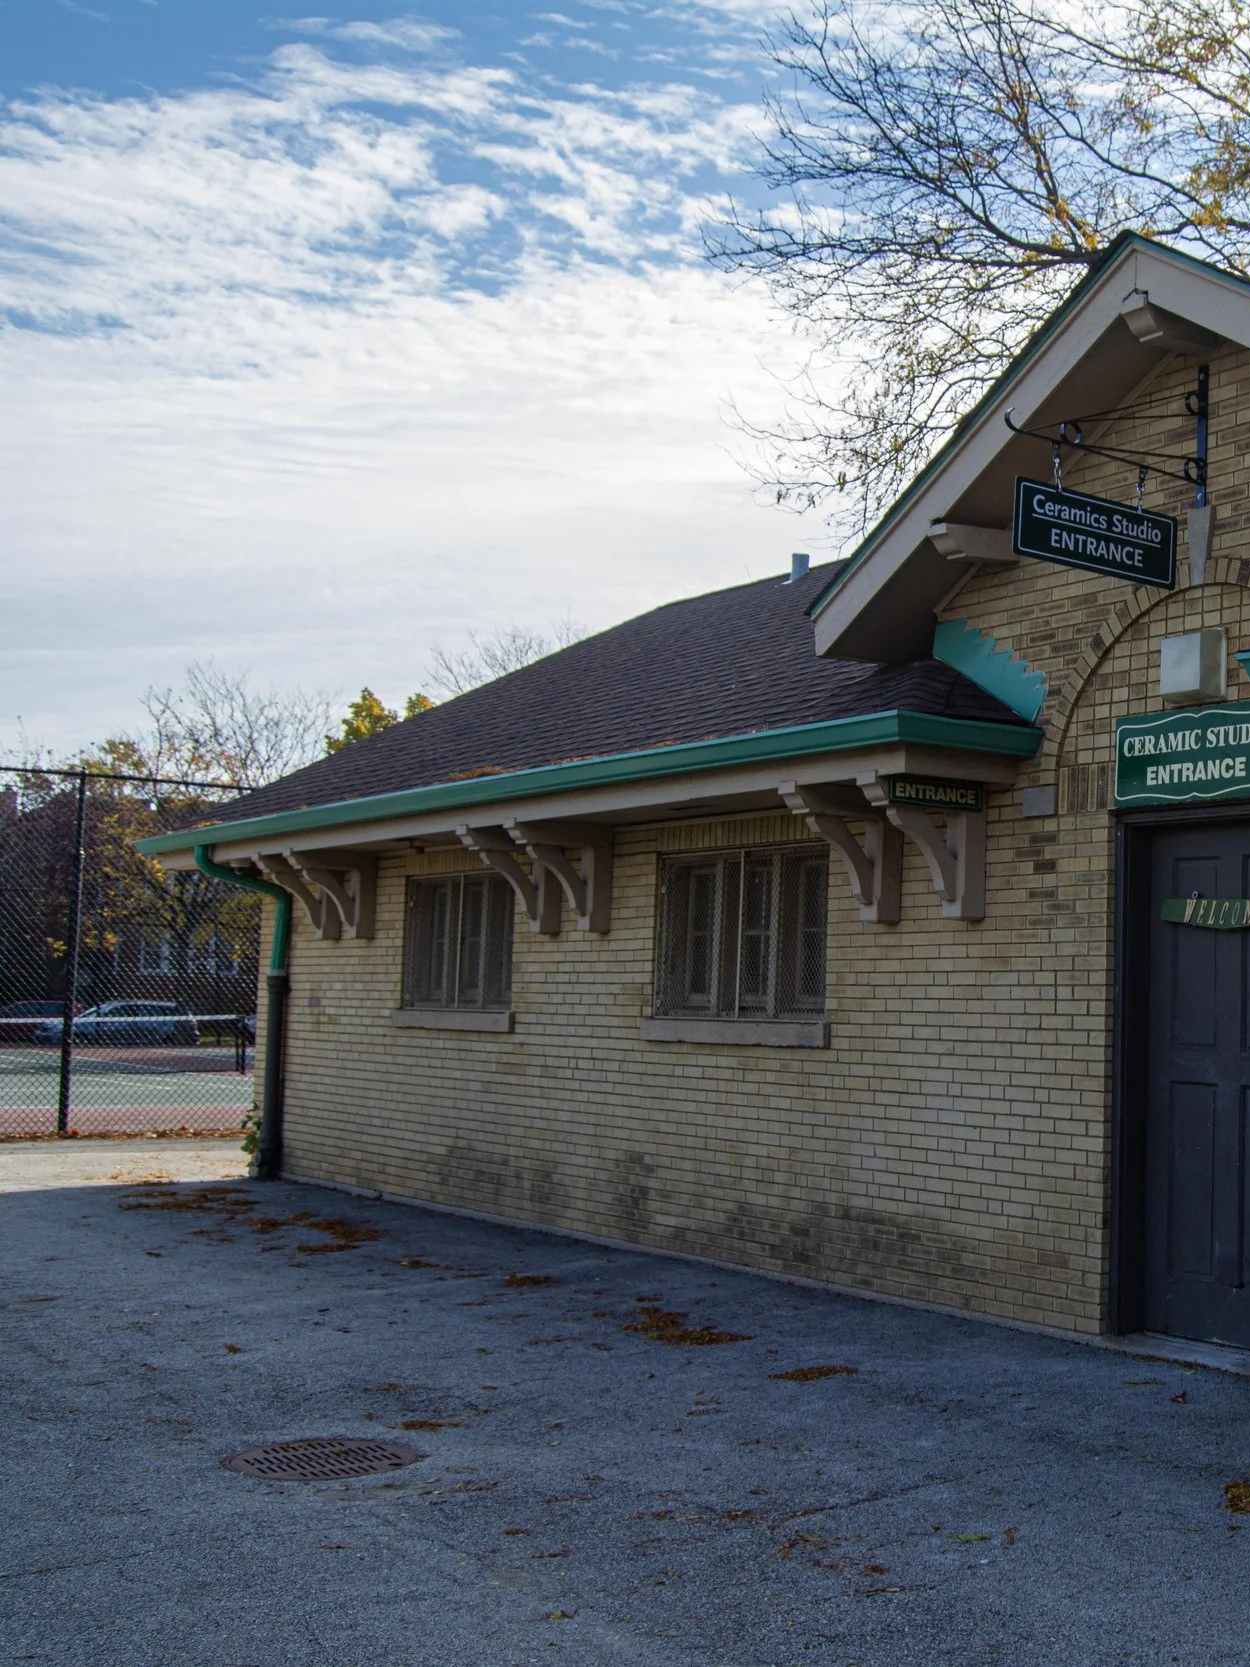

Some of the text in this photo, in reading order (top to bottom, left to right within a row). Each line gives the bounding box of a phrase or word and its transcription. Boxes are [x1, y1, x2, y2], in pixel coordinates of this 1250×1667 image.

[1033, 494, 1162, 543] Ceramics Studio
[1051, 528, 1144, 567] ENTRANCE
[1123, 729, 1201, 757] CERAMIC
[1147, 757, 1247, 786] ENTRANCE
[895, 782, 977, 804] ENTRANCE
